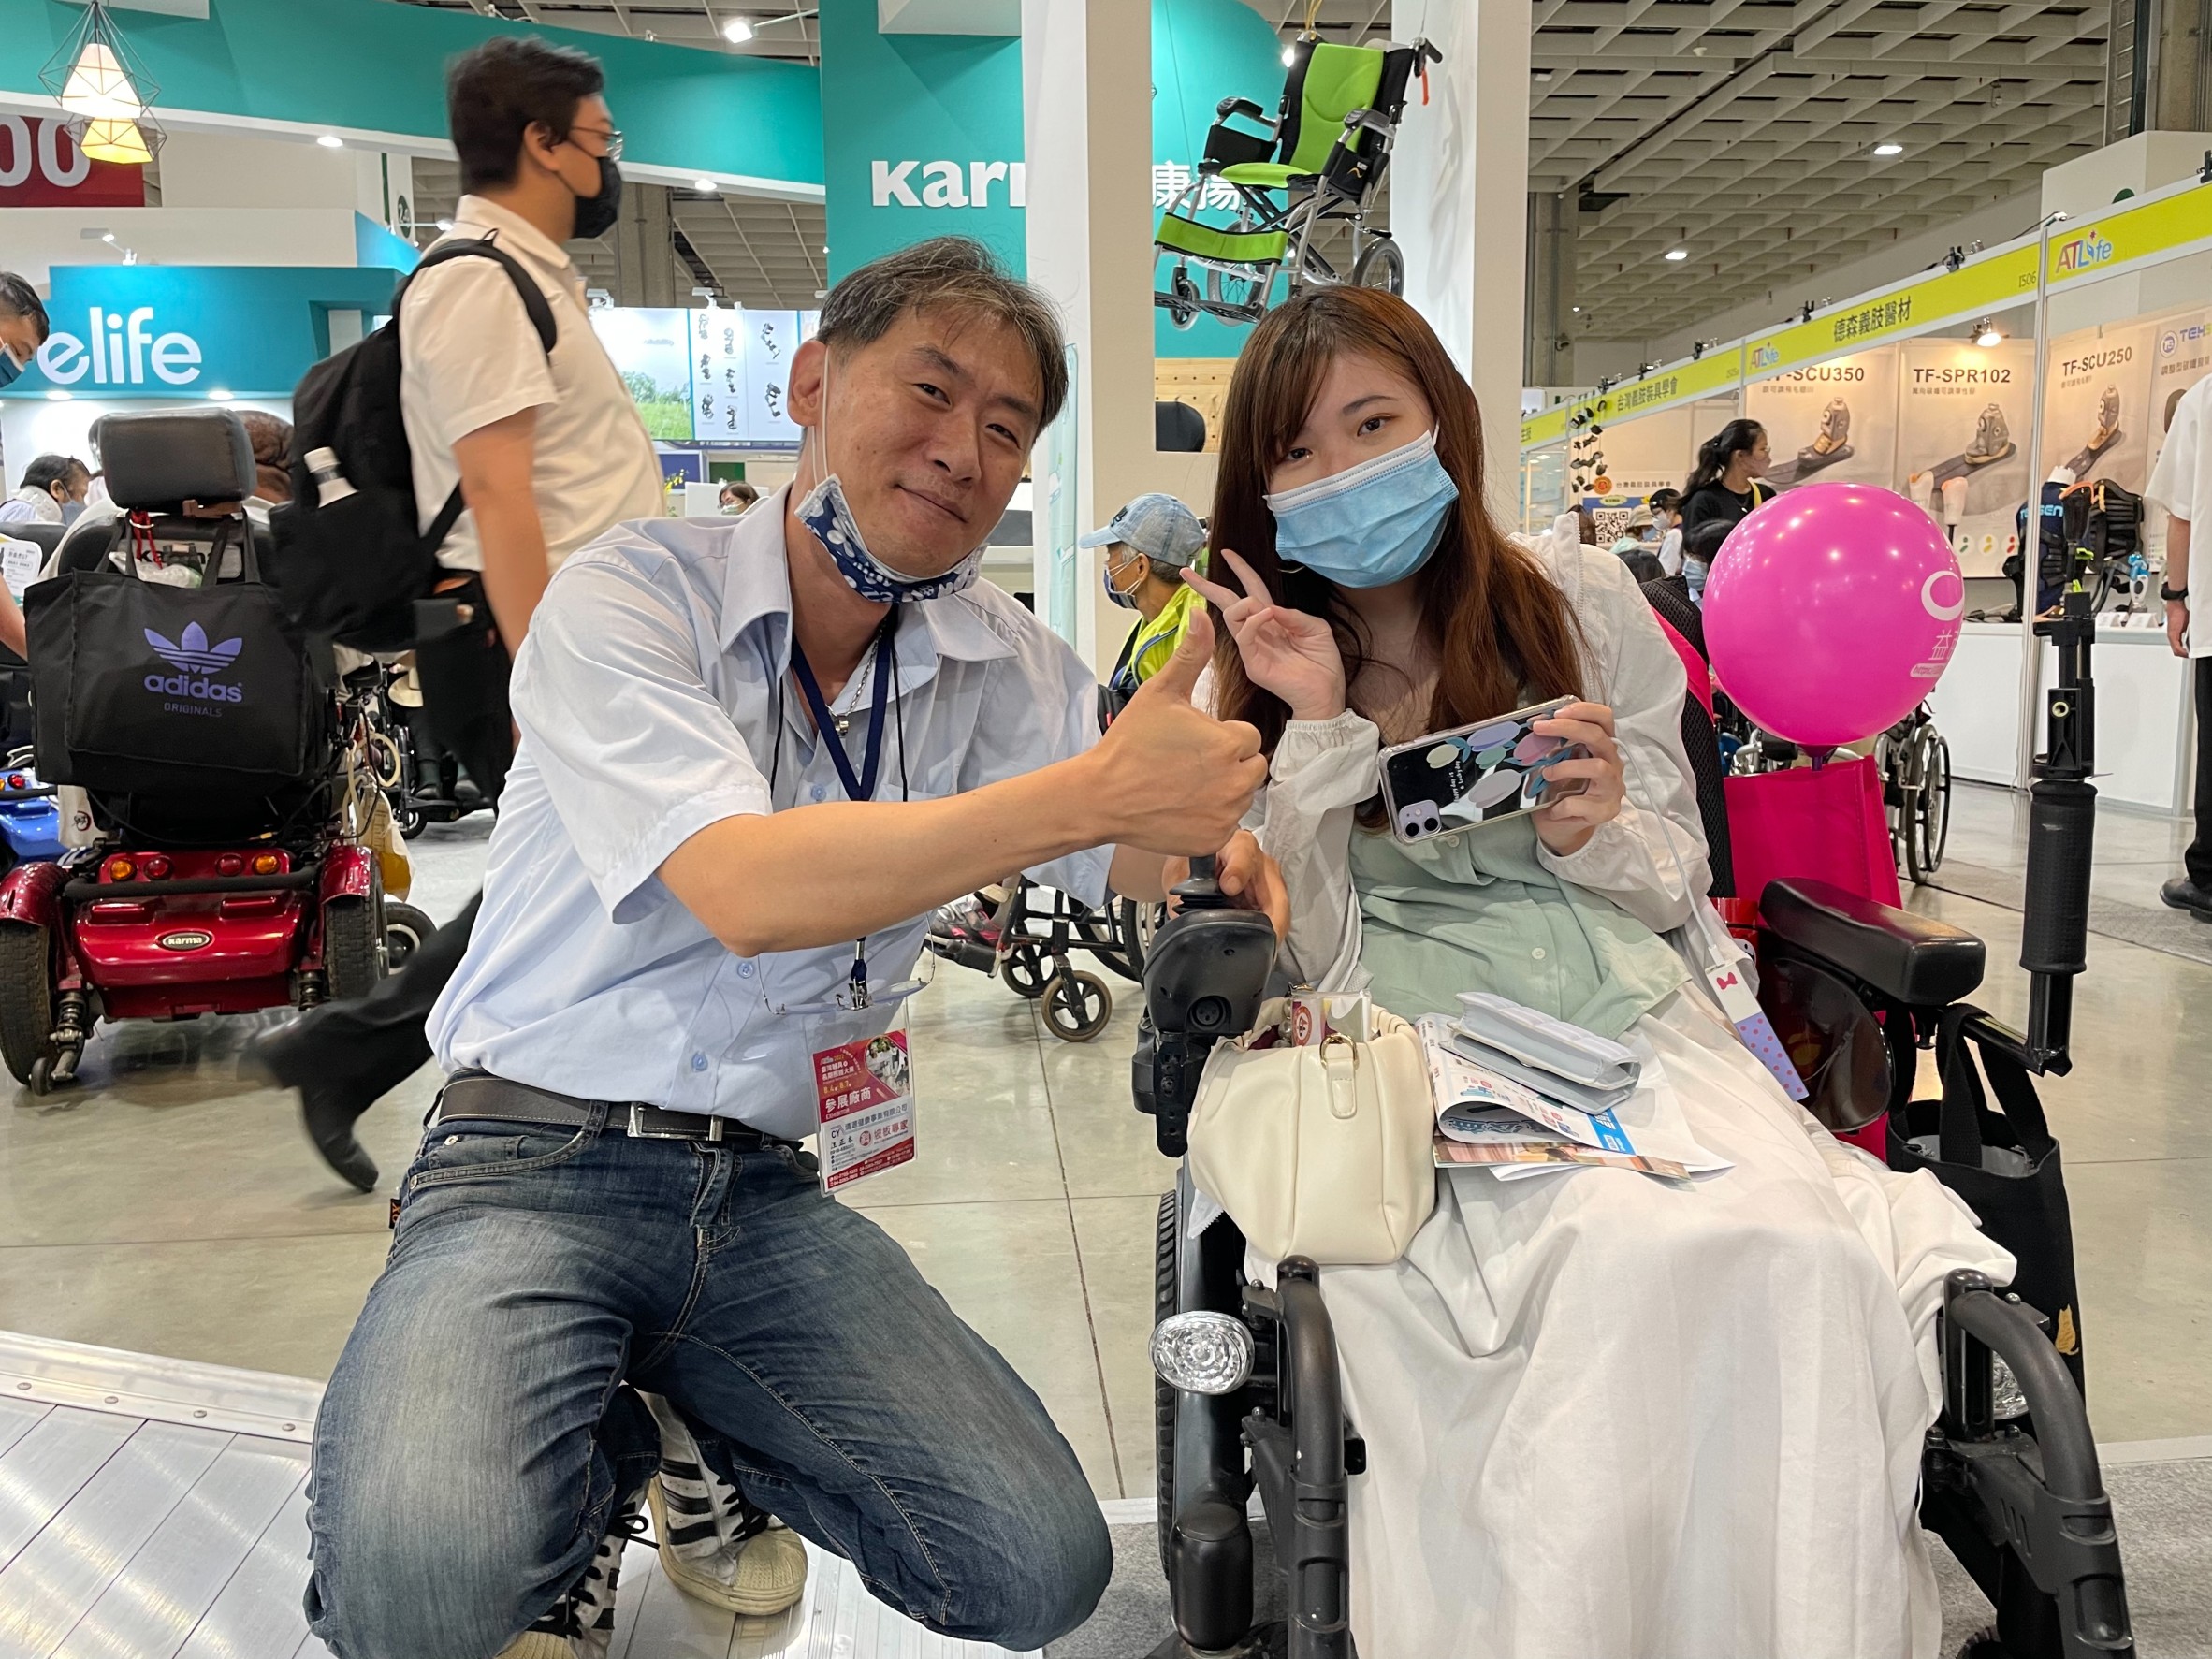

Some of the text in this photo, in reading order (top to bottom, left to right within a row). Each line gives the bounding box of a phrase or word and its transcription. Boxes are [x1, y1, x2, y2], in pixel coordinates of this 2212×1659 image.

[871, 160, 1026, 209] Kar
[2062, 346, 2132, 377] TF-SCU250
[1767, 366, 1865, 382] -SCU350
[1913, 368, 2012, 383] TF-SPR102
[144, 674, 243, 703] adidas
[164, 702, 223, 718] ORIGINALS
